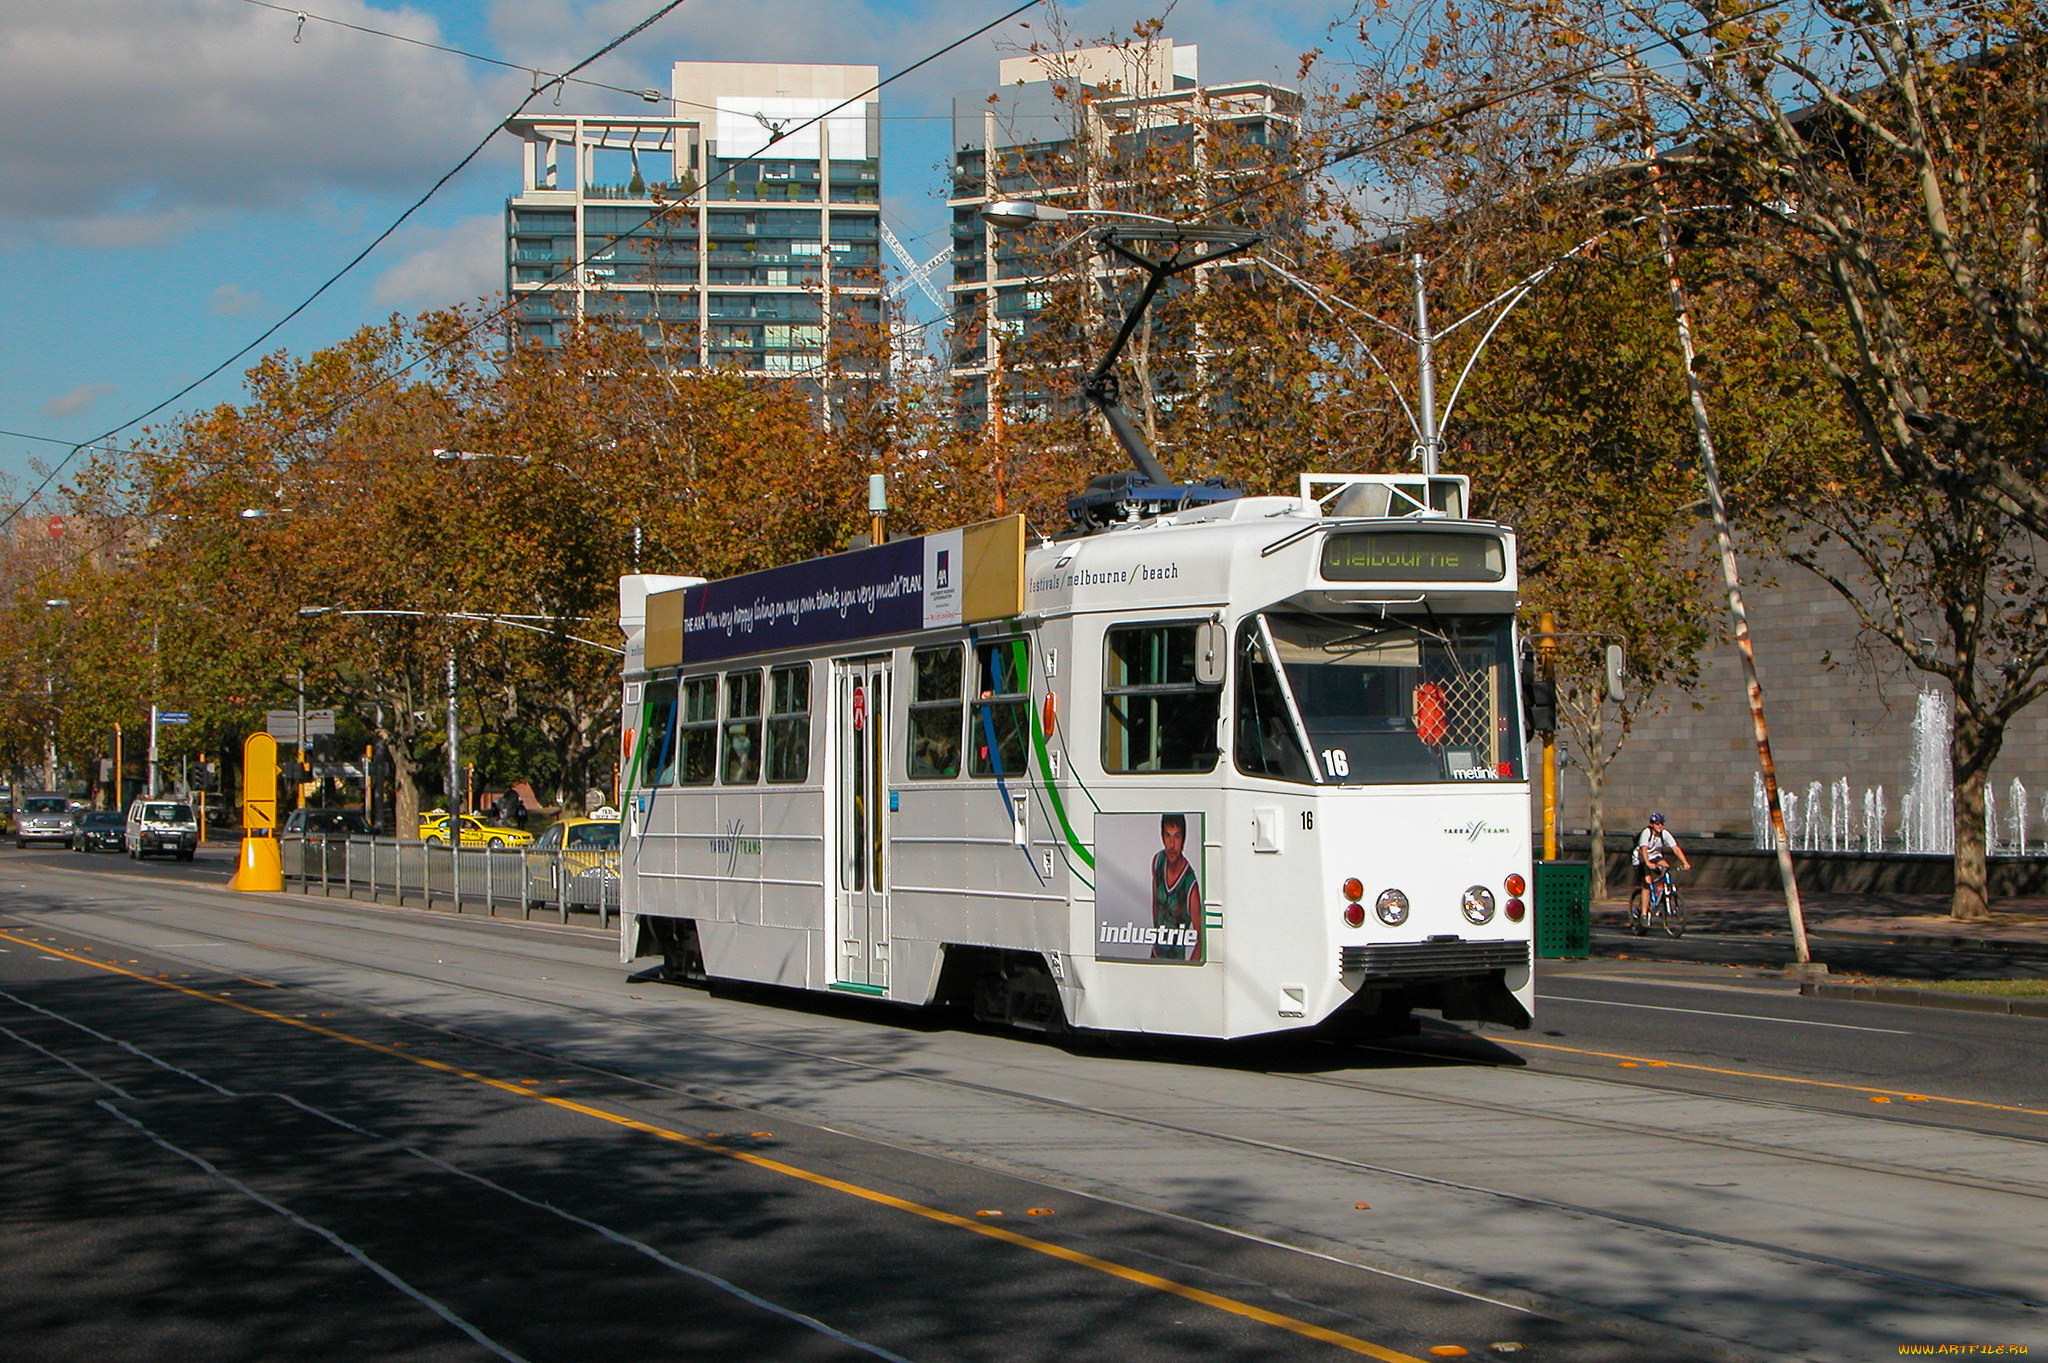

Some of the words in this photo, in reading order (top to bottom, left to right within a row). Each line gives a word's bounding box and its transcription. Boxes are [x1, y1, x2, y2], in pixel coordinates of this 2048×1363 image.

[1142, 562, 1179, 581] beach
[683, 618, 694, 633] THE
[718, 611, 733, 637] very
[733, 604, 754, 633] happy
[754, 595, 775, 625] living
[775, 602, 786, 618] on
[786, 598, 800, 626] my
[800, 596, 816, 614] own
[816, 586, 840, 610] thank
[840, 589, 857, 619] you
[857, 585, 876, 614] very
[1322, 749, 1350, 778] 16
[1452, 765, 1499, 780] metlink
[1301, 810, 1314, 831] 16
[709, 840, 729, 854] YARRA
[740, 840, 761, 856] TRAMS
[1100, 921, 1198, 946] industrie
